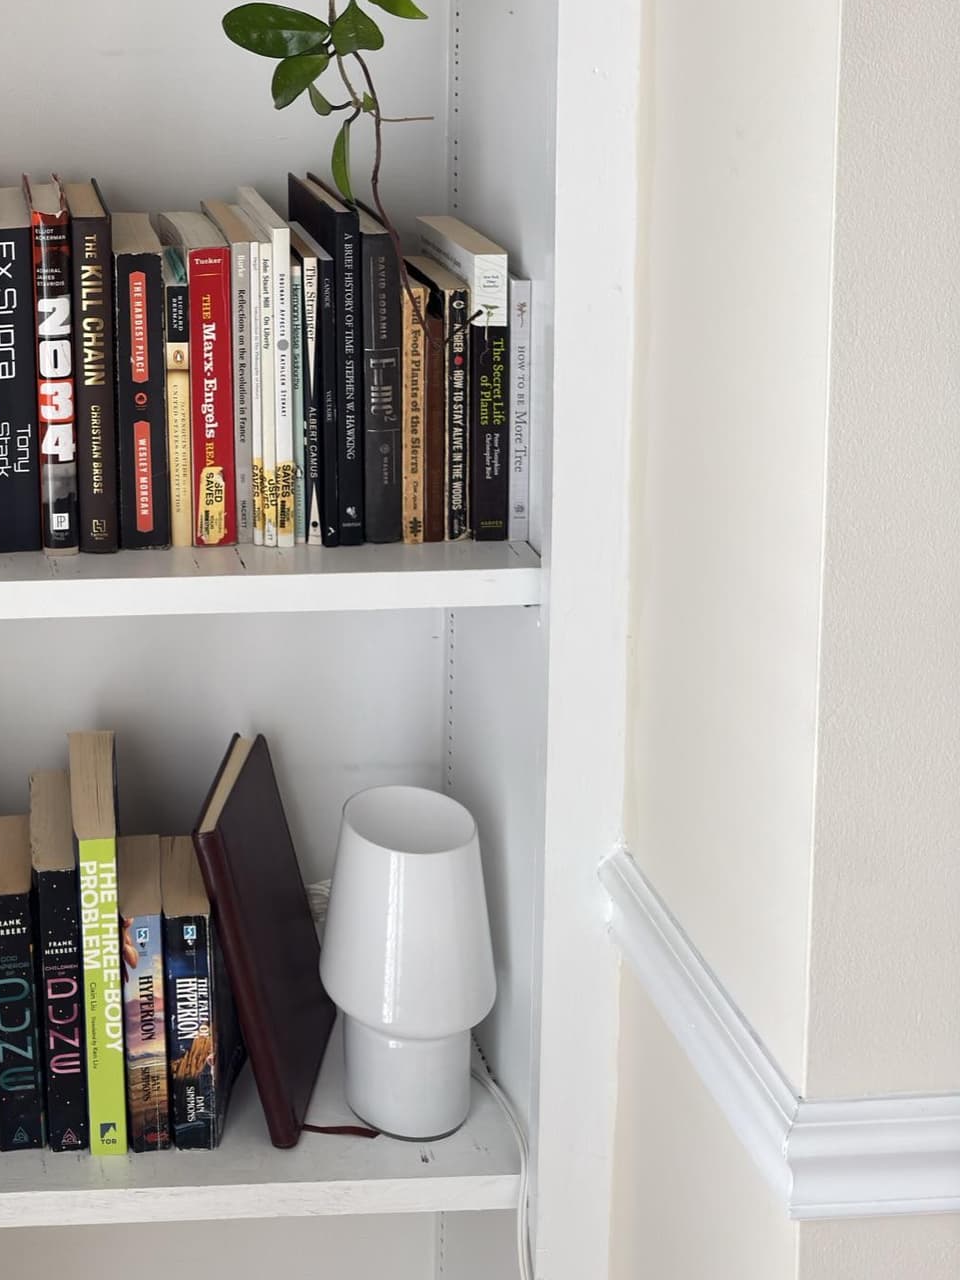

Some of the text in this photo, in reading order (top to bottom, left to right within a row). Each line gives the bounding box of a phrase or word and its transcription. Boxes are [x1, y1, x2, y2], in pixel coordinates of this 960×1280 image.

[344, 243, 353, 269] BRIEF
[81, 234, 105, 385] THE KILL CHAIN
[344, 272, 353, 312] HISTORY
[345, 315, 353, 328] OF
[134, 282, 145, 373] THE HARDEST PLACE
[346, 331, 354, 354] TIME
[480, 376, 491, 425] of Plants
[493, 339, 504, 424] The Secret Life
[15, 425, 30, 472] Tony
[90, 405, 103, 493] CHRISTIAN BROSE
[309, 406, 318, 478] ALBERT CAMUS
[453, 370, 464, 510] HOW TO STAY ALIVE IN THE WOODS
[138, 439, 149, 515] WESLEY MORGAN
[281, 464, 291, 498] SAVES
[80, 860, 100, 969] PROBLEM
[100, 858, 123, 1052] THE THREE-BODY
[139, 976, 155, 1041] HYPERION
[176, 978, 198, 1039] HYPERION
